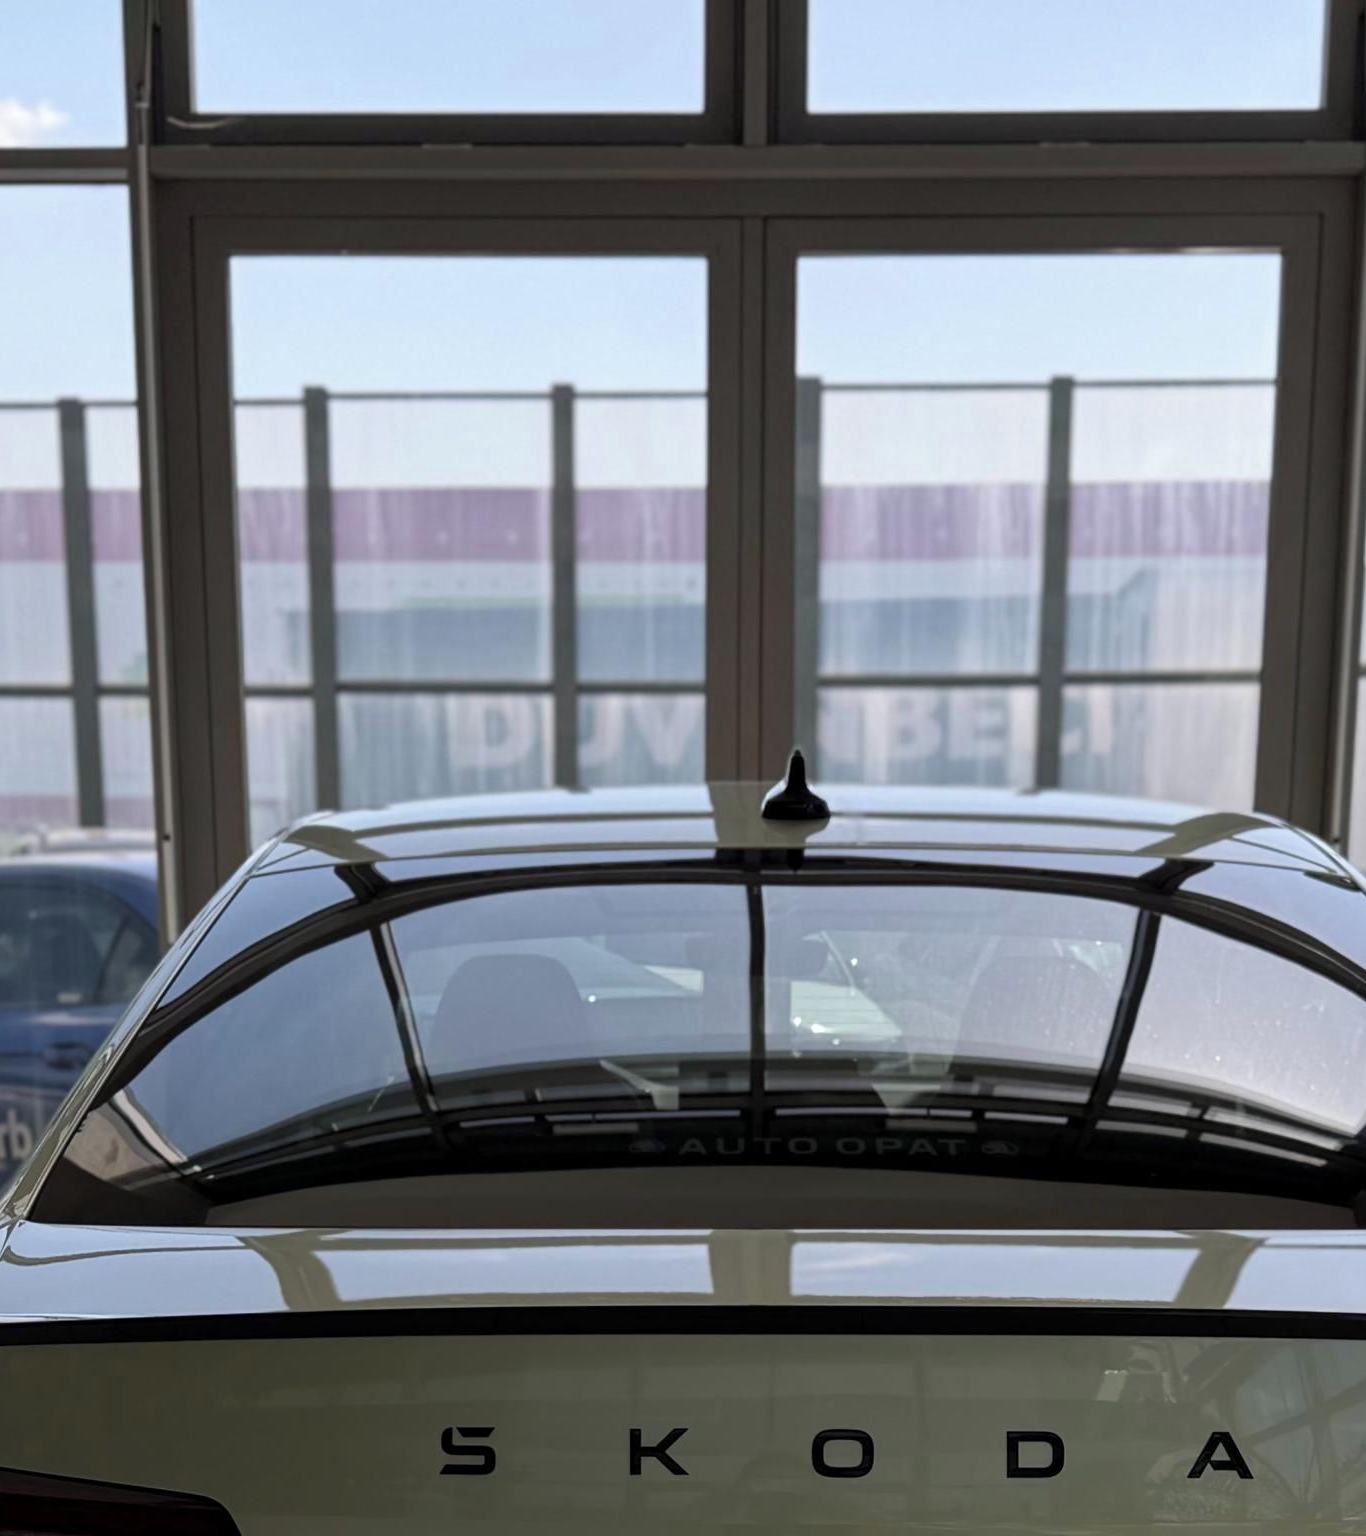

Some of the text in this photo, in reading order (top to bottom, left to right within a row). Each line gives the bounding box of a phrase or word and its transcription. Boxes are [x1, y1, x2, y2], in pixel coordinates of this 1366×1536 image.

[678, 1137, 966, 1156] AUTO OPAT
[439, 1426, 1255, 1480] SKODA
